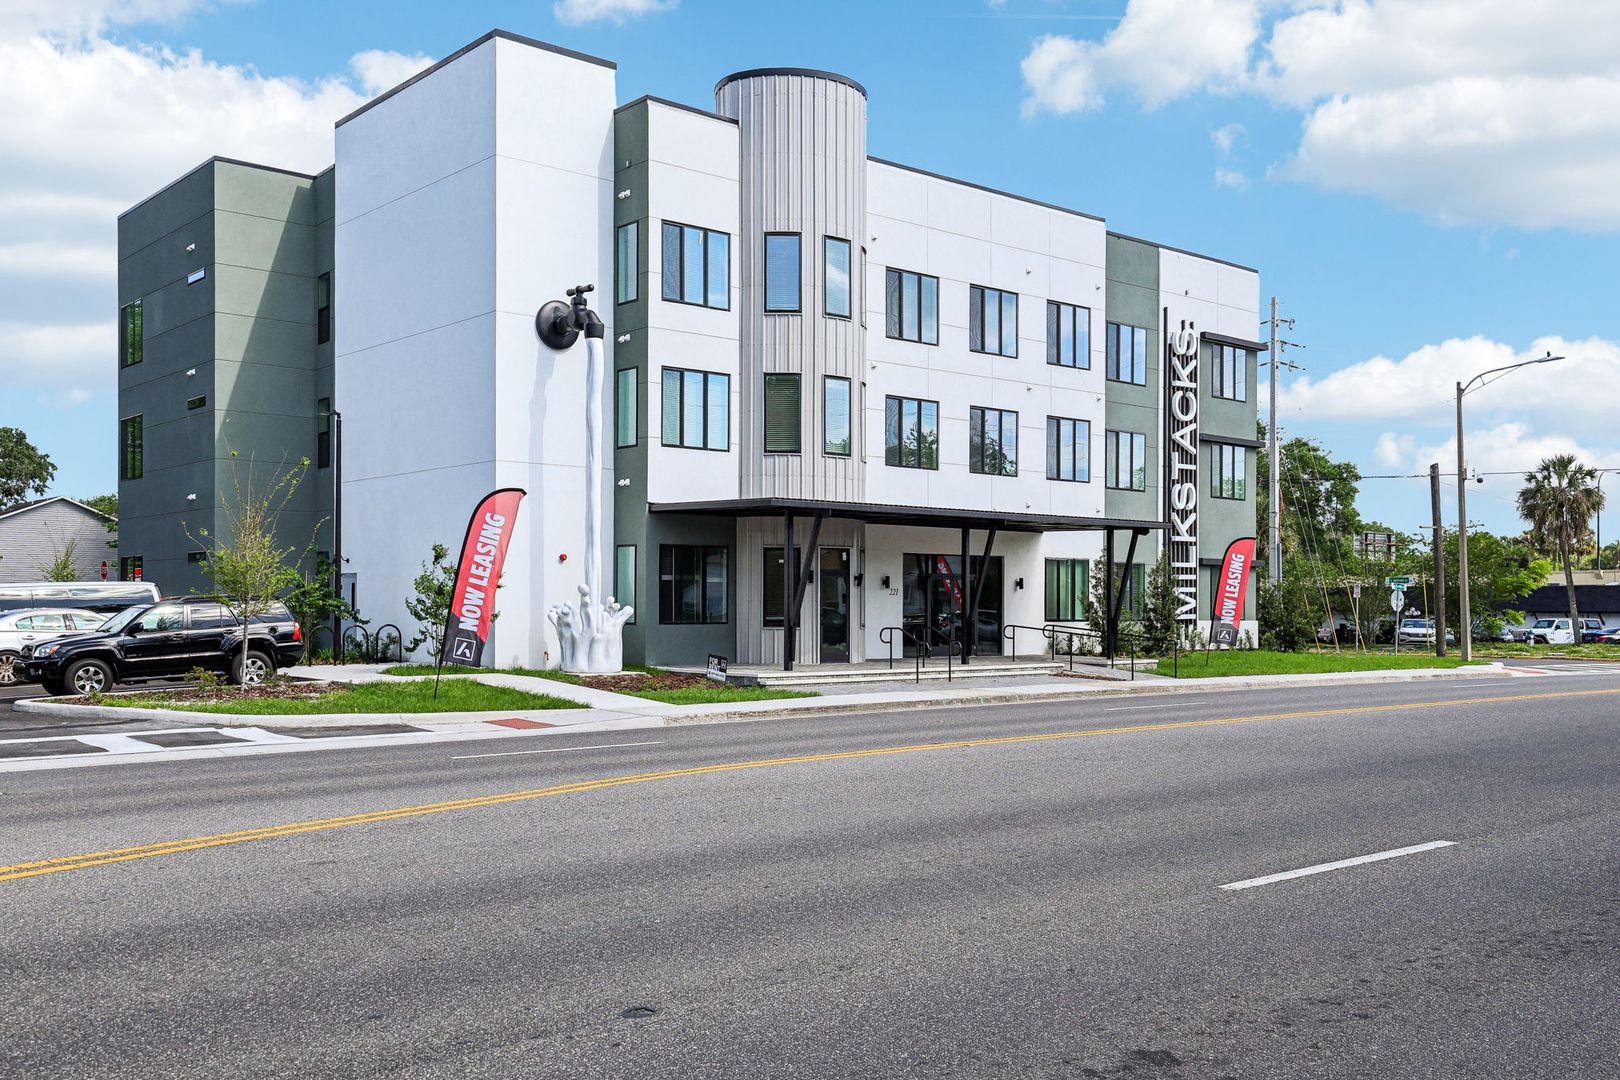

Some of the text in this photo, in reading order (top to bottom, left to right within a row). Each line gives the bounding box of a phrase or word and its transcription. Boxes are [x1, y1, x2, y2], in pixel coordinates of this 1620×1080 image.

[1171, 328, 1198, 620] MILKSTACKS
[458, 512, 506, 632] NOW LEASING
[888, 588, 899, 596] 221
[1220, 553, 1245, 625] NOW LEASING
[709, 656, 718, 665] FOR
[709, 664, 720, 672] RENT
